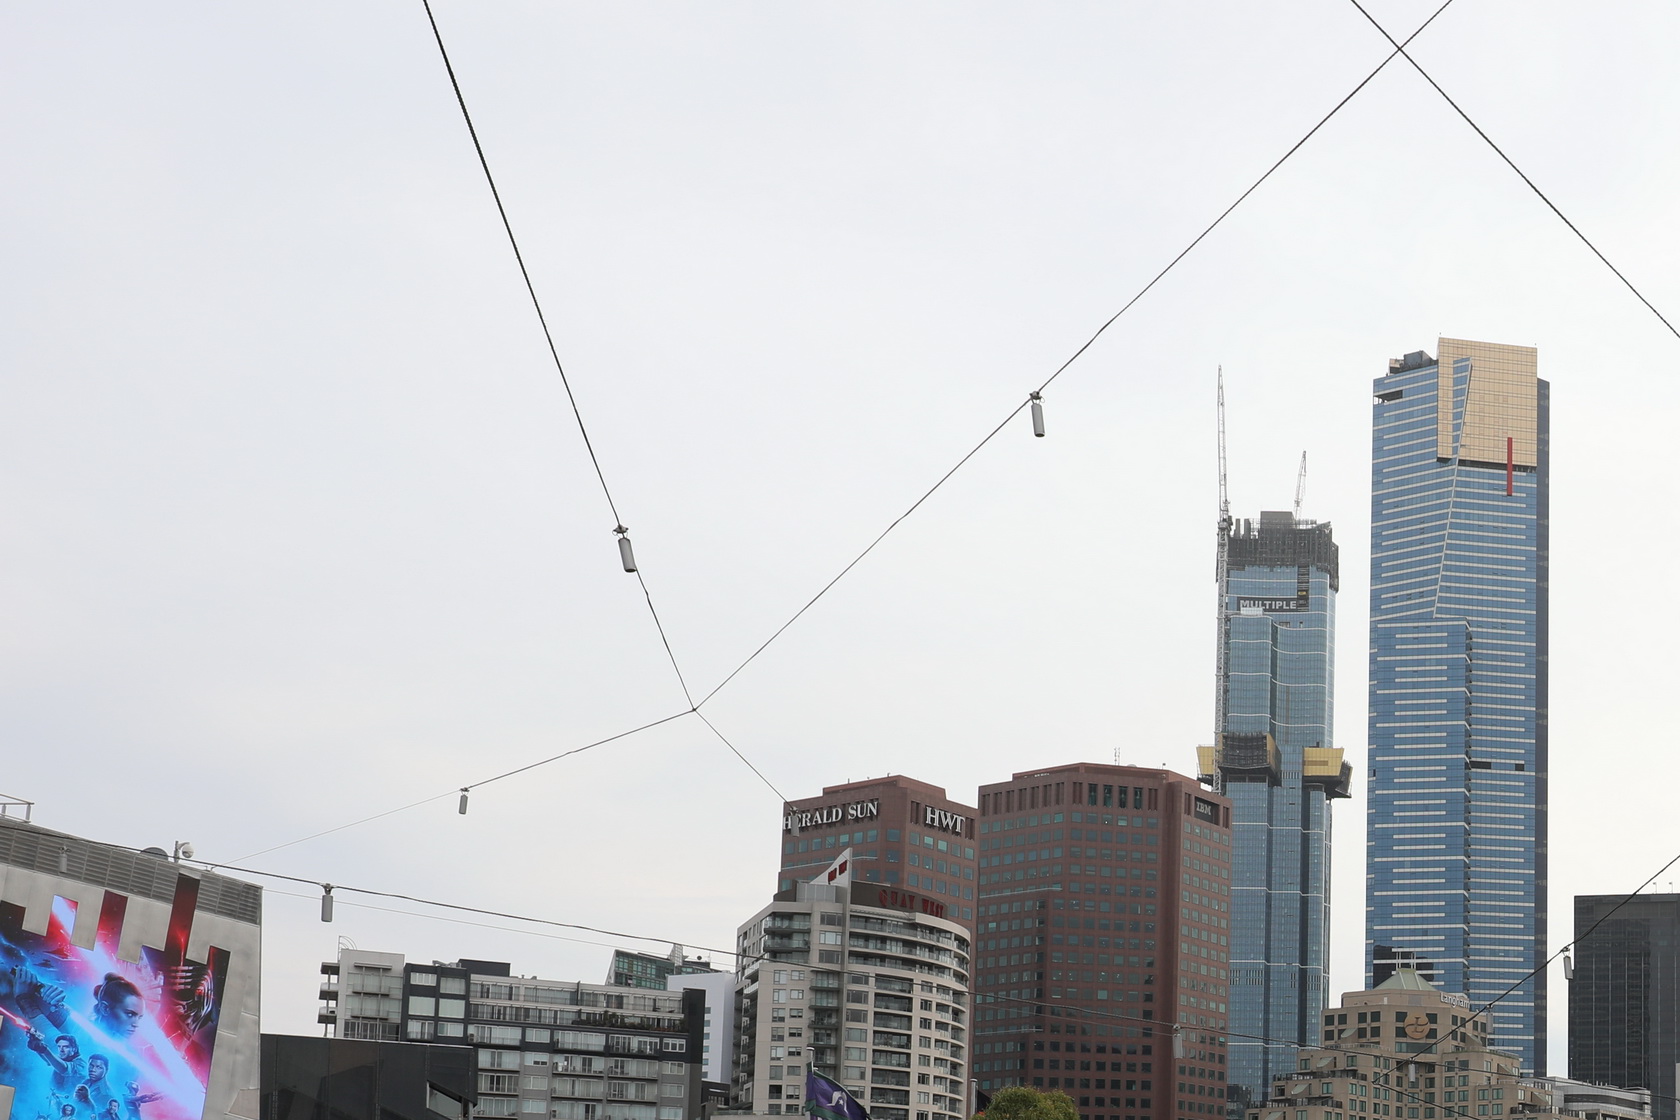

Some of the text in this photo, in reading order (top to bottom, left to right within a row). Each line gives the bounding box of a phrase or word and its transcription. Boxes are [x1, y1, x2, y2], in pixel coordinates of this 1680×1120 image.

[1240, 600, 1297, 609] MULTIPLE
[783, 801, 878, 830] HRALD SUN
[925, 806, 965, 832] HWT
[1196, 802, 1211, 815] IBM
[879, 889, 944, 918] QUAY WEST
[1441, 991, 1470, 1008] Langham
